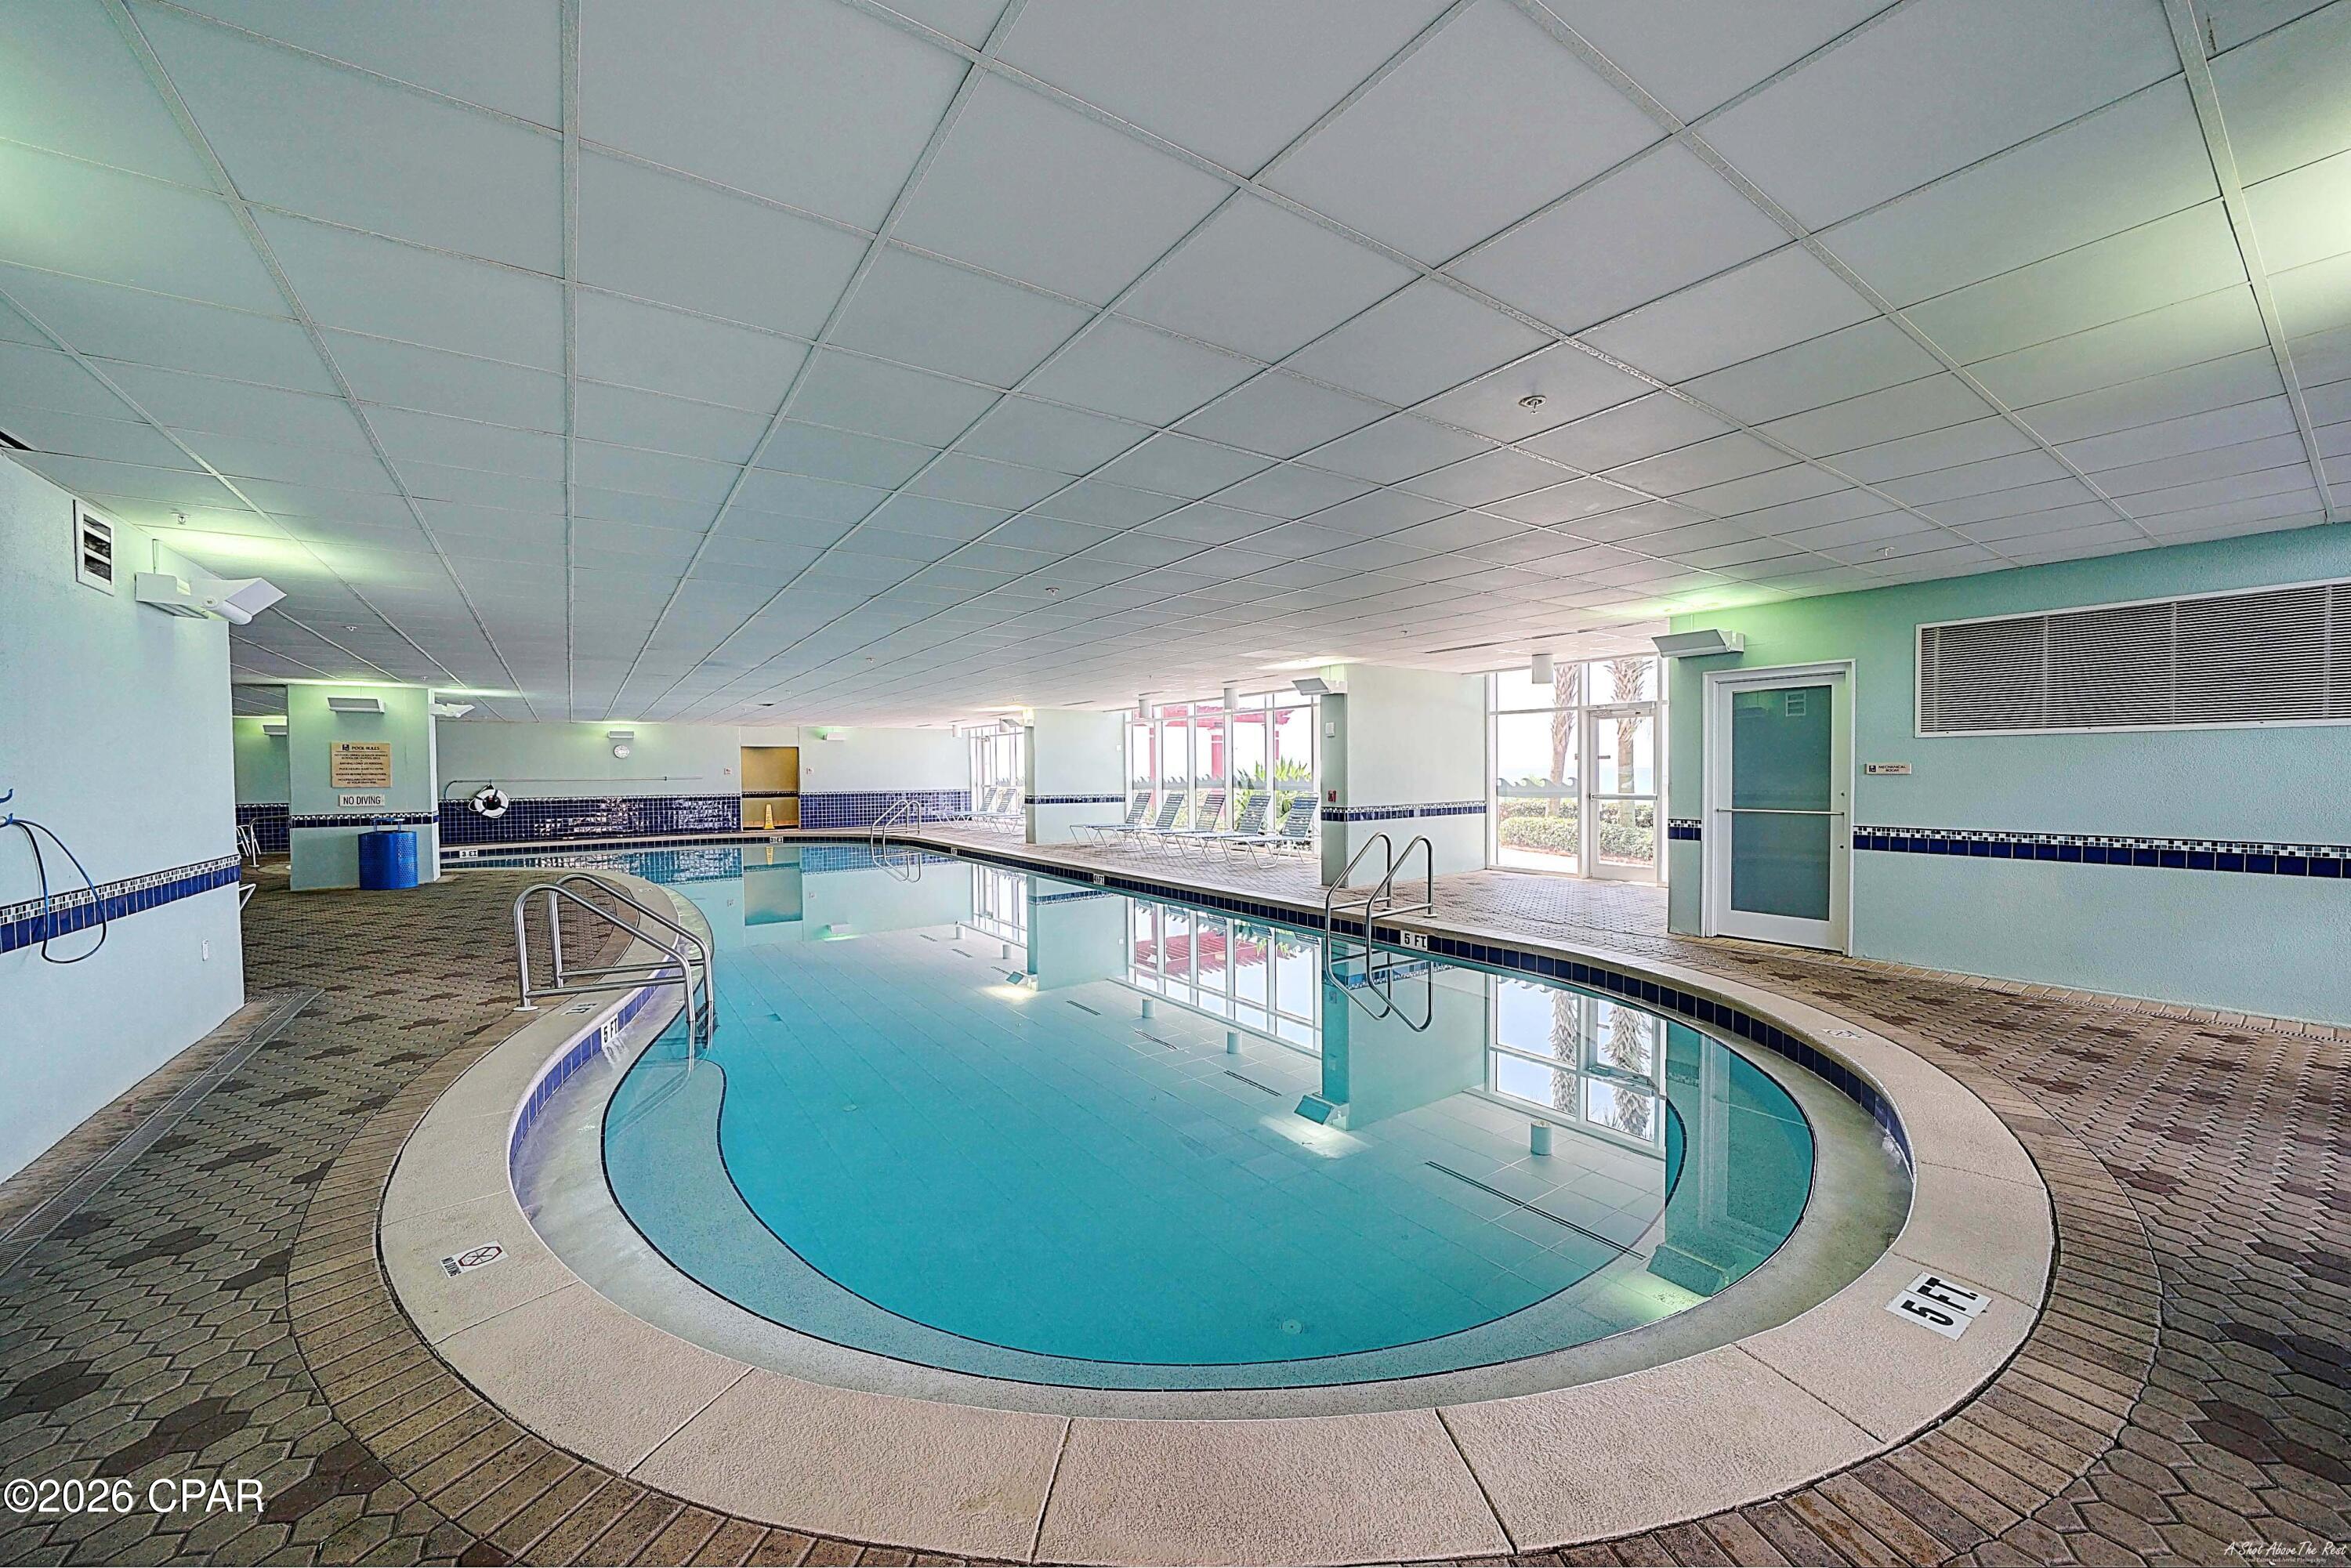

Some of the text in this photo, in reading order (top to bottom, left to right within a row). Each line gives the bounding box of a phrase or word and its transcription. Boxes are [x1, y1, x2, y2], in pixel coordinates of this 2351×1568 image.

[343, 796, 381, 805] NO DIVING
[1404, 932, 1410, 944] 5
[603, 1025, 608, 1043] 5
[1900, 1299, 1954, 1326] 5
